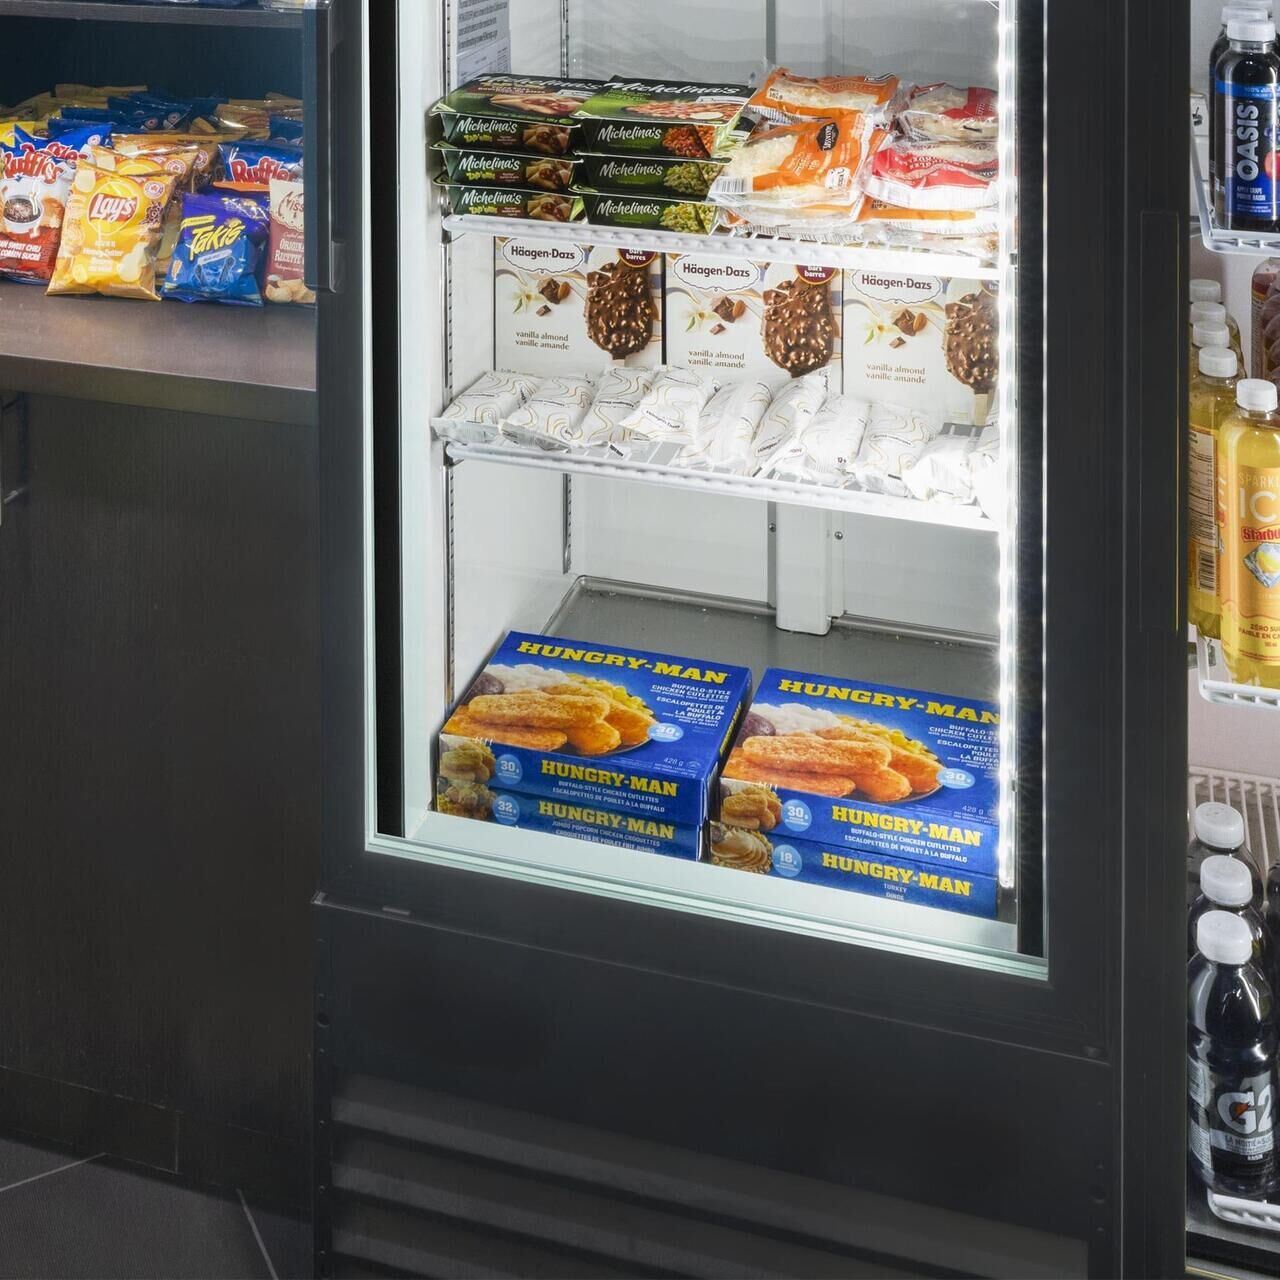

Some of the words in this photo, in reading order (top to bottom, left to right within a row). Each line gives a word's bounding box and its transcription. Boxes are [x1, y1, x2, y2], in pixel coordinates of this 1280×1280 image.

[456, 117, 518, 135] Michelina's
[596, 124, 662, 142] Michelina's
[1236, 104, 1260, 182] OASIS
[458, 154, 521, 172] Michelina's
[598, 160, 664, 179] Michelina's
[461, 189, 522, 206] Michelina's
[91, 193, 137, 223] Lay's
[596, 199, 661, 217] Michelina's
[188, 219, 246, 261] Takis
[510, 245, 576, 261] Häagen-Dazs
[625, 253, 647, 262] barres
[682, 262, 751, 279] Häagen-Dazs
[804, 270, 826, 279] barres
[861, 273, 933, 291] Häagen-Dazs
[514, 338, 539, 348] vanille
[539, 341, 570, 351] amande
[515, 330, 539, 340] vanilla
[540, 332, 569, 342] almond
[687, 357, 712, 367] vanille
[713, 359, 746, 369] amande
[688, 349, 713, 359] vanilla
[714, 350, 745, 361] almond
[866, 363, 893, 374] vanilla
[894, 365, 926, 375] almond
[866, 372, 892, 383] vanille
[893, 374, 927, 384] amande
[517, 641, 728, 685] HUNGRY-MAN
[651, 684, 686, 695] CHICKEN
[686, 688, 730, 700] CUTLETTES
[671, 682, 732, 695] BUFFALO-STYLE
[656, 696, 714, 710] ESCALOPETTES
[777, 678, 1000, 725] HUNGRY-MAN
[686, 706, 716, 715] POULET
[687, 711, 721, 721] BUFFALO
[928, 726, 966, 737] CHICKEN
[541, 759, 679, 797] HUNGRY-MAN
[552, 787, 594, 801] ESCALOPETTES
[602, 796, 625, 807] POULET
[639, 802, 666, 813] BUFFALO
[558, 781, 602, 793] BUFFALO-STYLE
[602, 787, 627, 798] CHICKEN
[627, 792, 660, 804] CUTLETTES
[538, 799, 675, 840] HUNGRY-MAN
[831, 805, 981, 847] HUNGRY-MAN
[571, 824, 599, 836] POPCORN
[599, 828, 624, 840] CHICKEN
[850, 827, 899, 843] BUFFALO-STYLE
[898, 835, 927, 847] CHICKEN
[926, 840, 962, 853] CUTLETTES
[844, 834, 890, 850] ESCALOPETTES
[900, 843, 924, 855] POULET
[940, 851, 968, 864] BUFFALO
[821, 852, 971, 897] HUNGRY-MAN
[883, 882, 908, 894] TURKEY
[1217, 1083, 1273, 1135] G2
[1247, 1153, 1264, 1161] RAISIN
